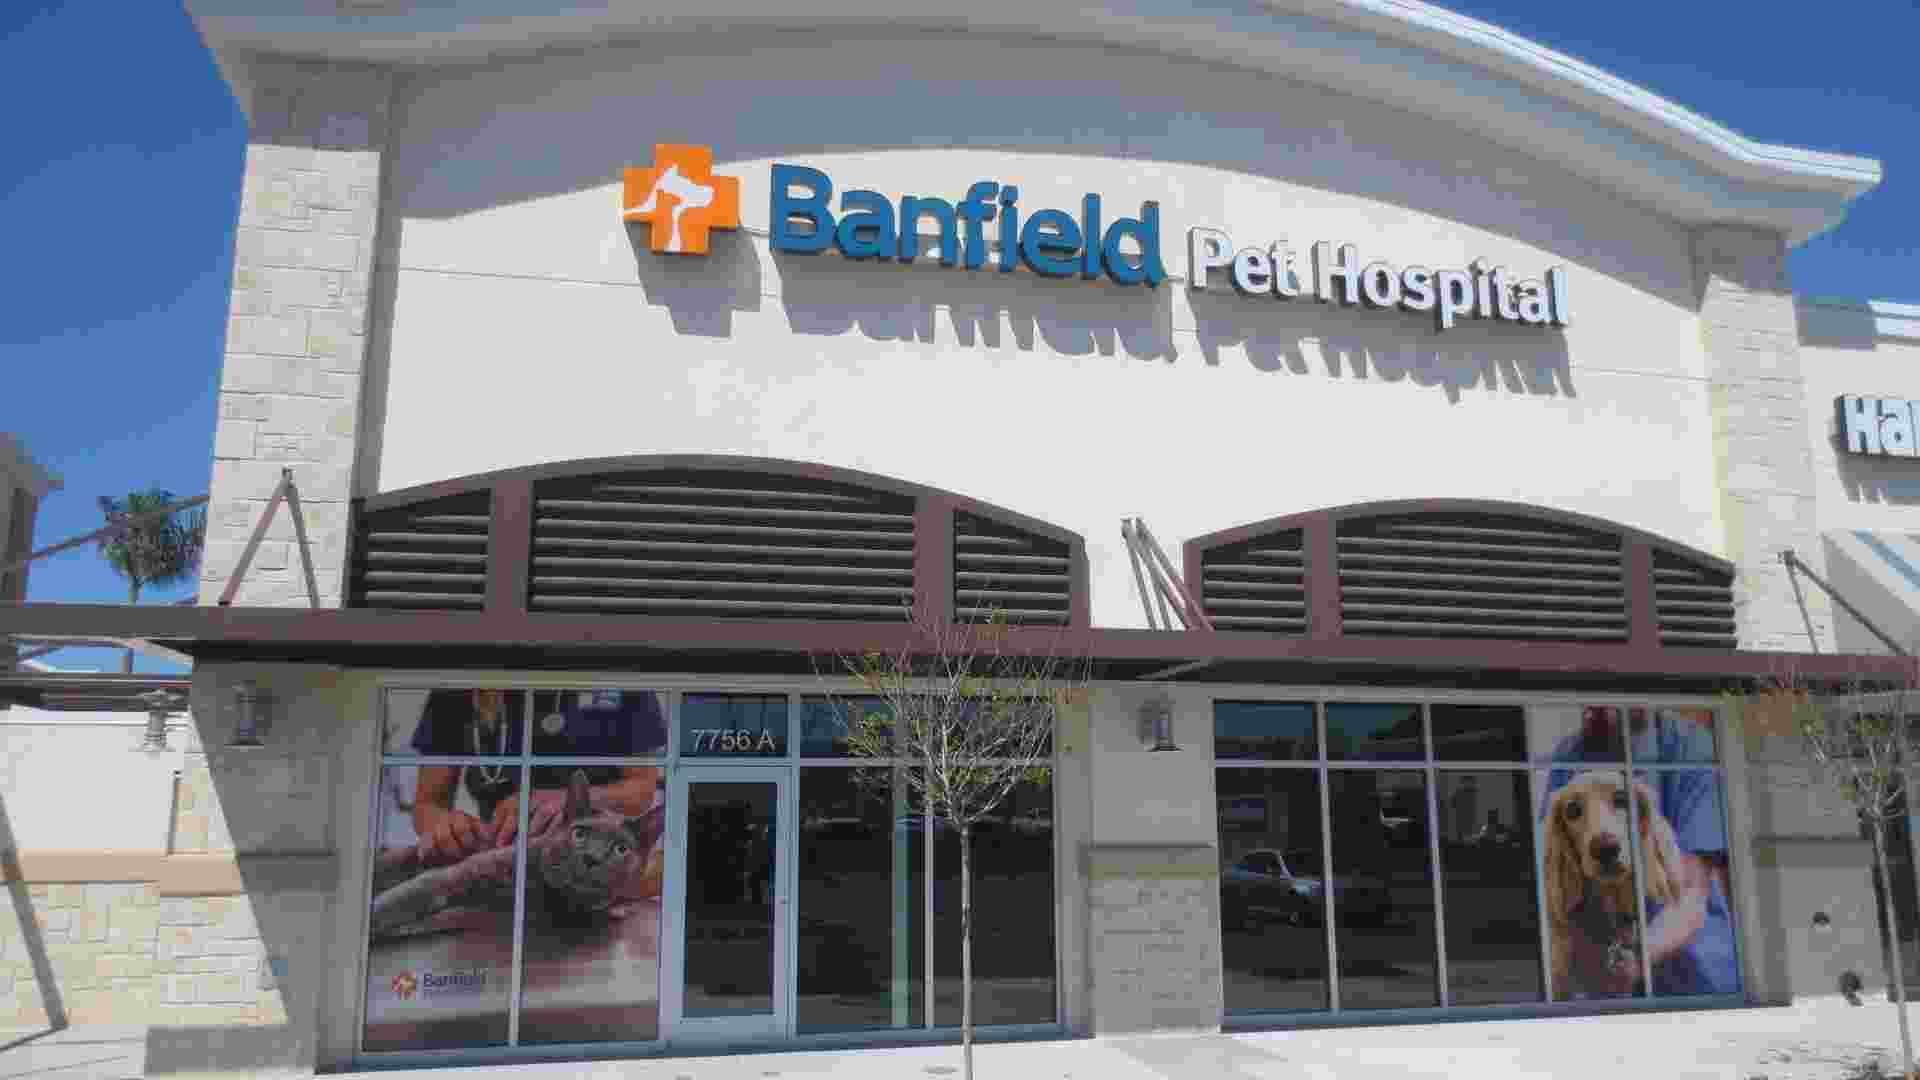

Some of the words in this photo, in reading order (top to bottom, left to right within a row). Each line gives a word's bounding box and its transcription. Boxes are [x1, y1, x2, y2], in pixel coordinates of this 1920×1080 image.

[769, 163, 1168, 287] Banfield
[1187, 226, 1300, 296] Pet
[1311, 240, 1569, 330] Hospital
[690, 728, 752, 752] 7756
[756, 728, 776, 752] A
